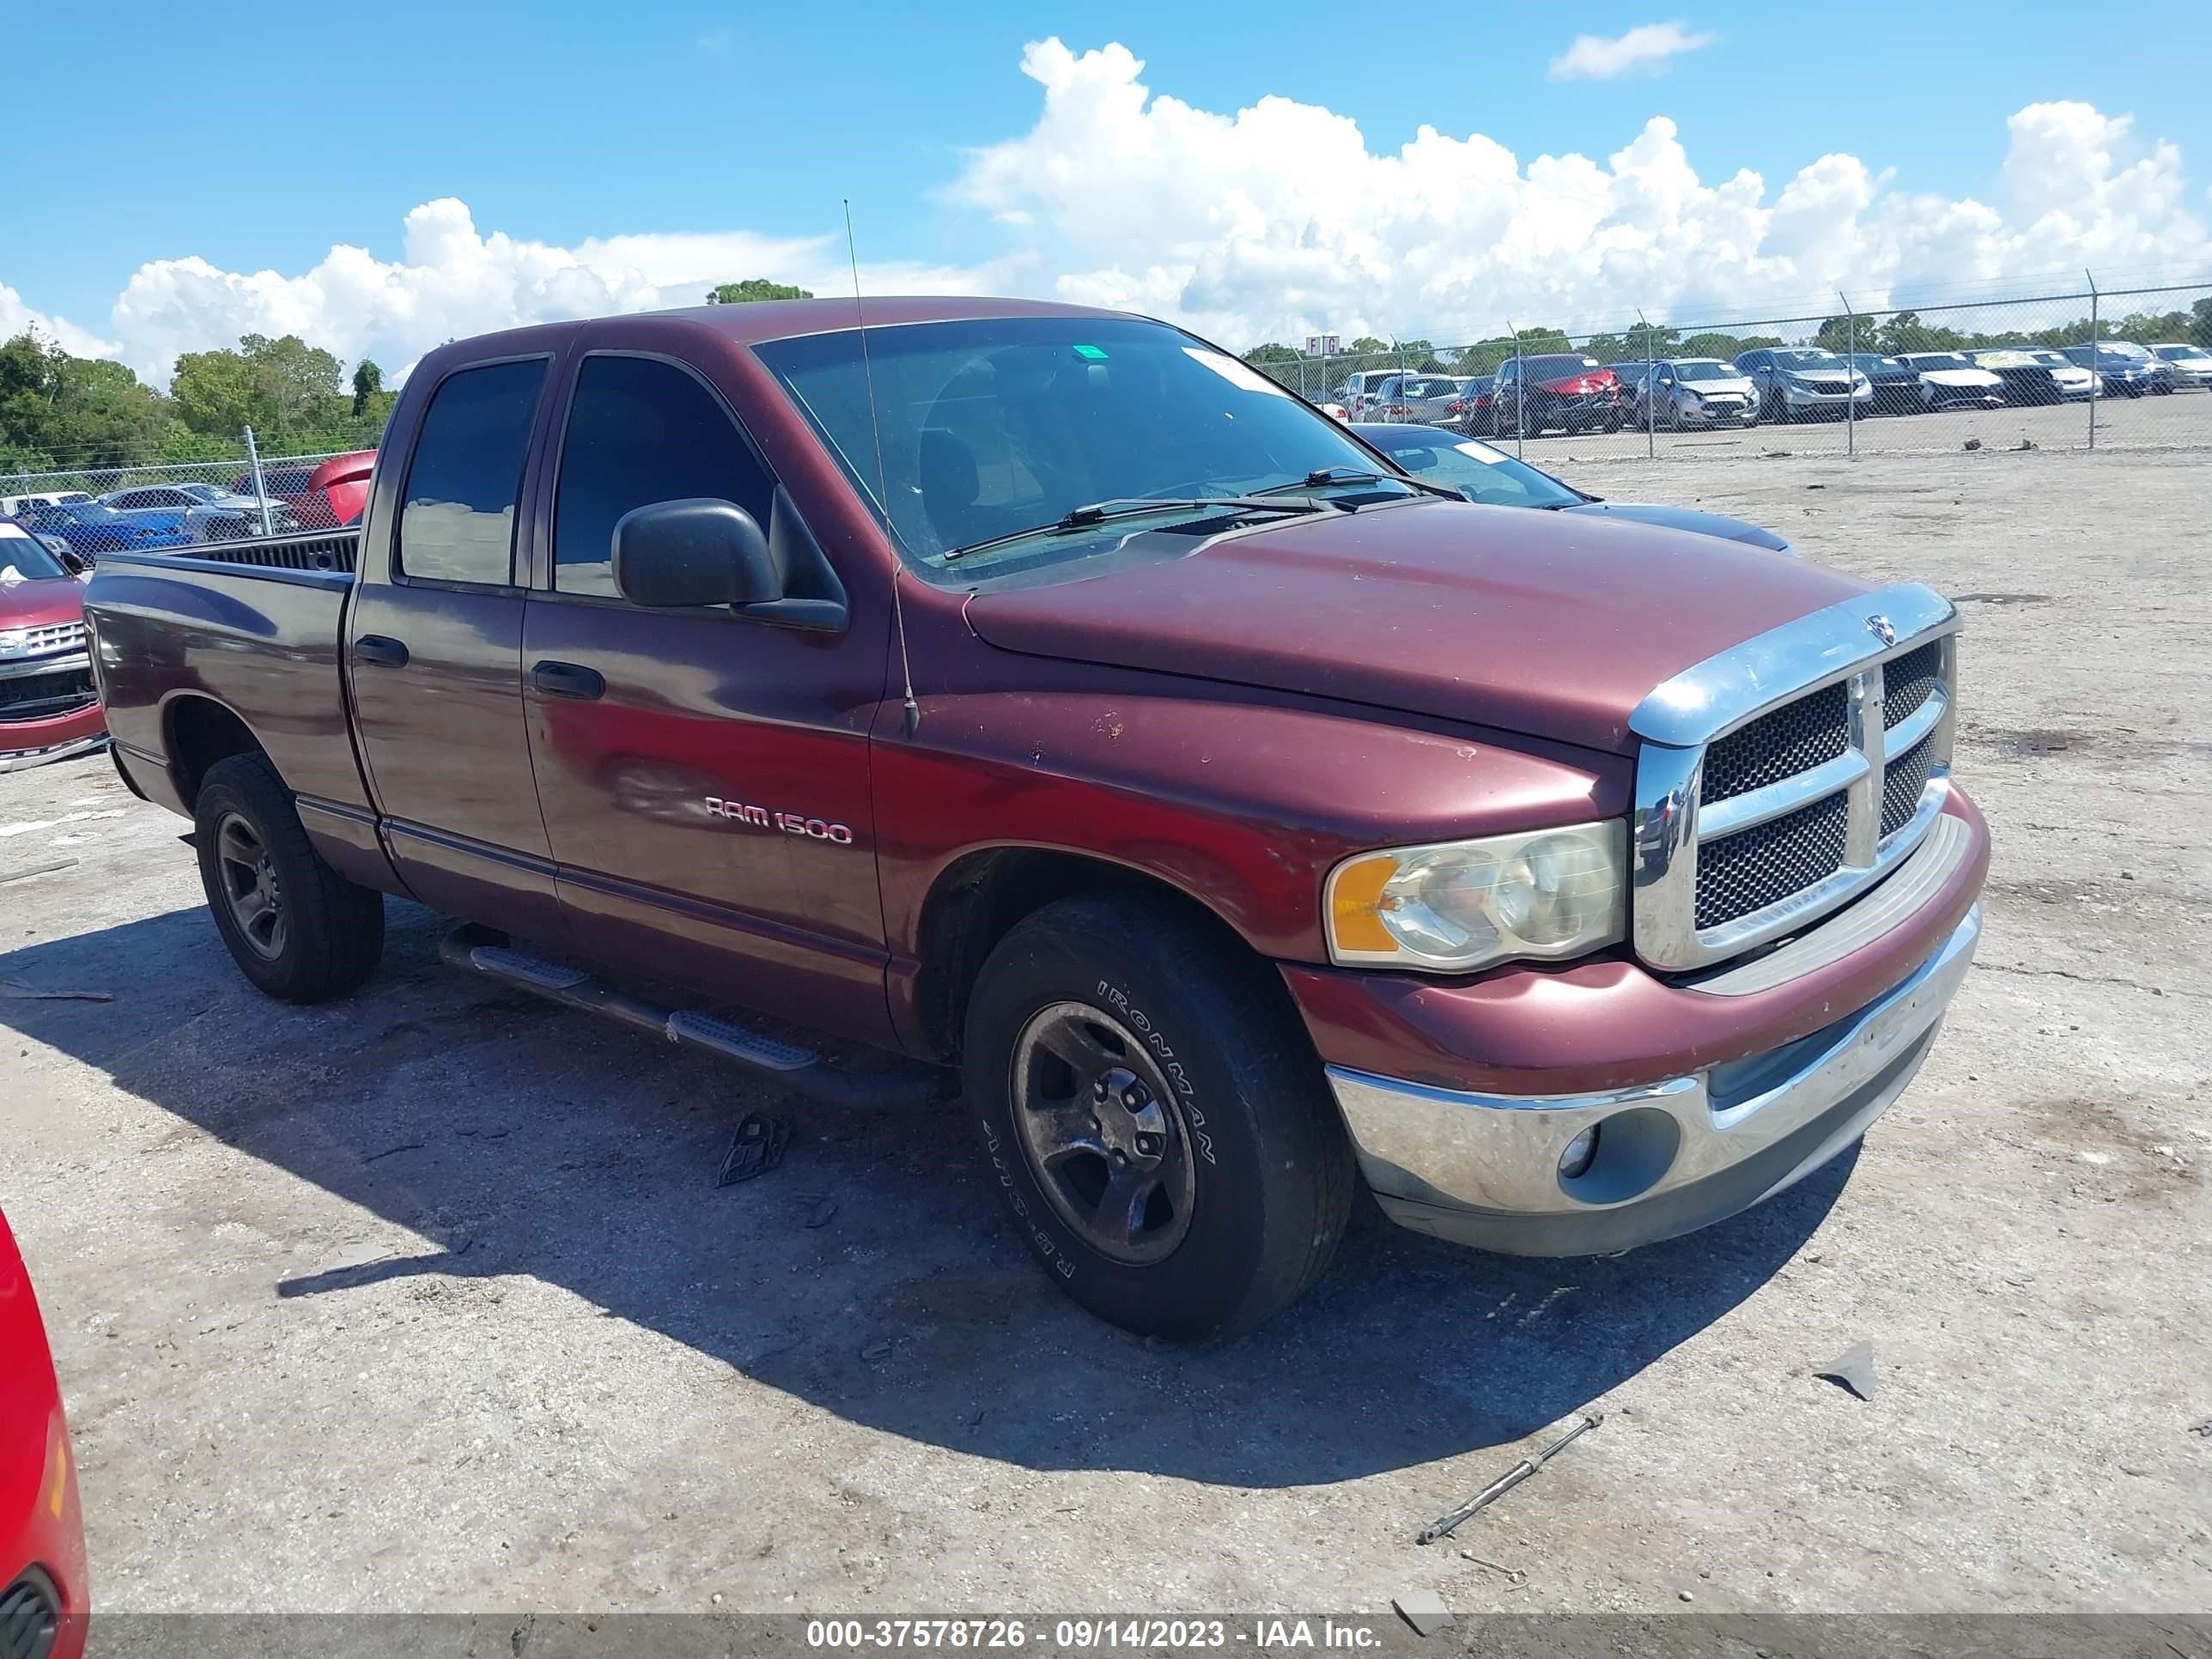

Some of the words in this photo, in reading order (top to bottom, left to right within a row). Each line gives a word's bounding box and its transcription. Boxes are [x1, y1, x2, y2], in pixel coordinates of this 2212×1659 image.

[1310, 338, 1316, 353] F
[1328, 337, 1335, 353] G
[705, 796, 769, 828] RAM
[775, 811, 853, 845] 1500
[1097, 980, 1217, 1166] IRONMAN
